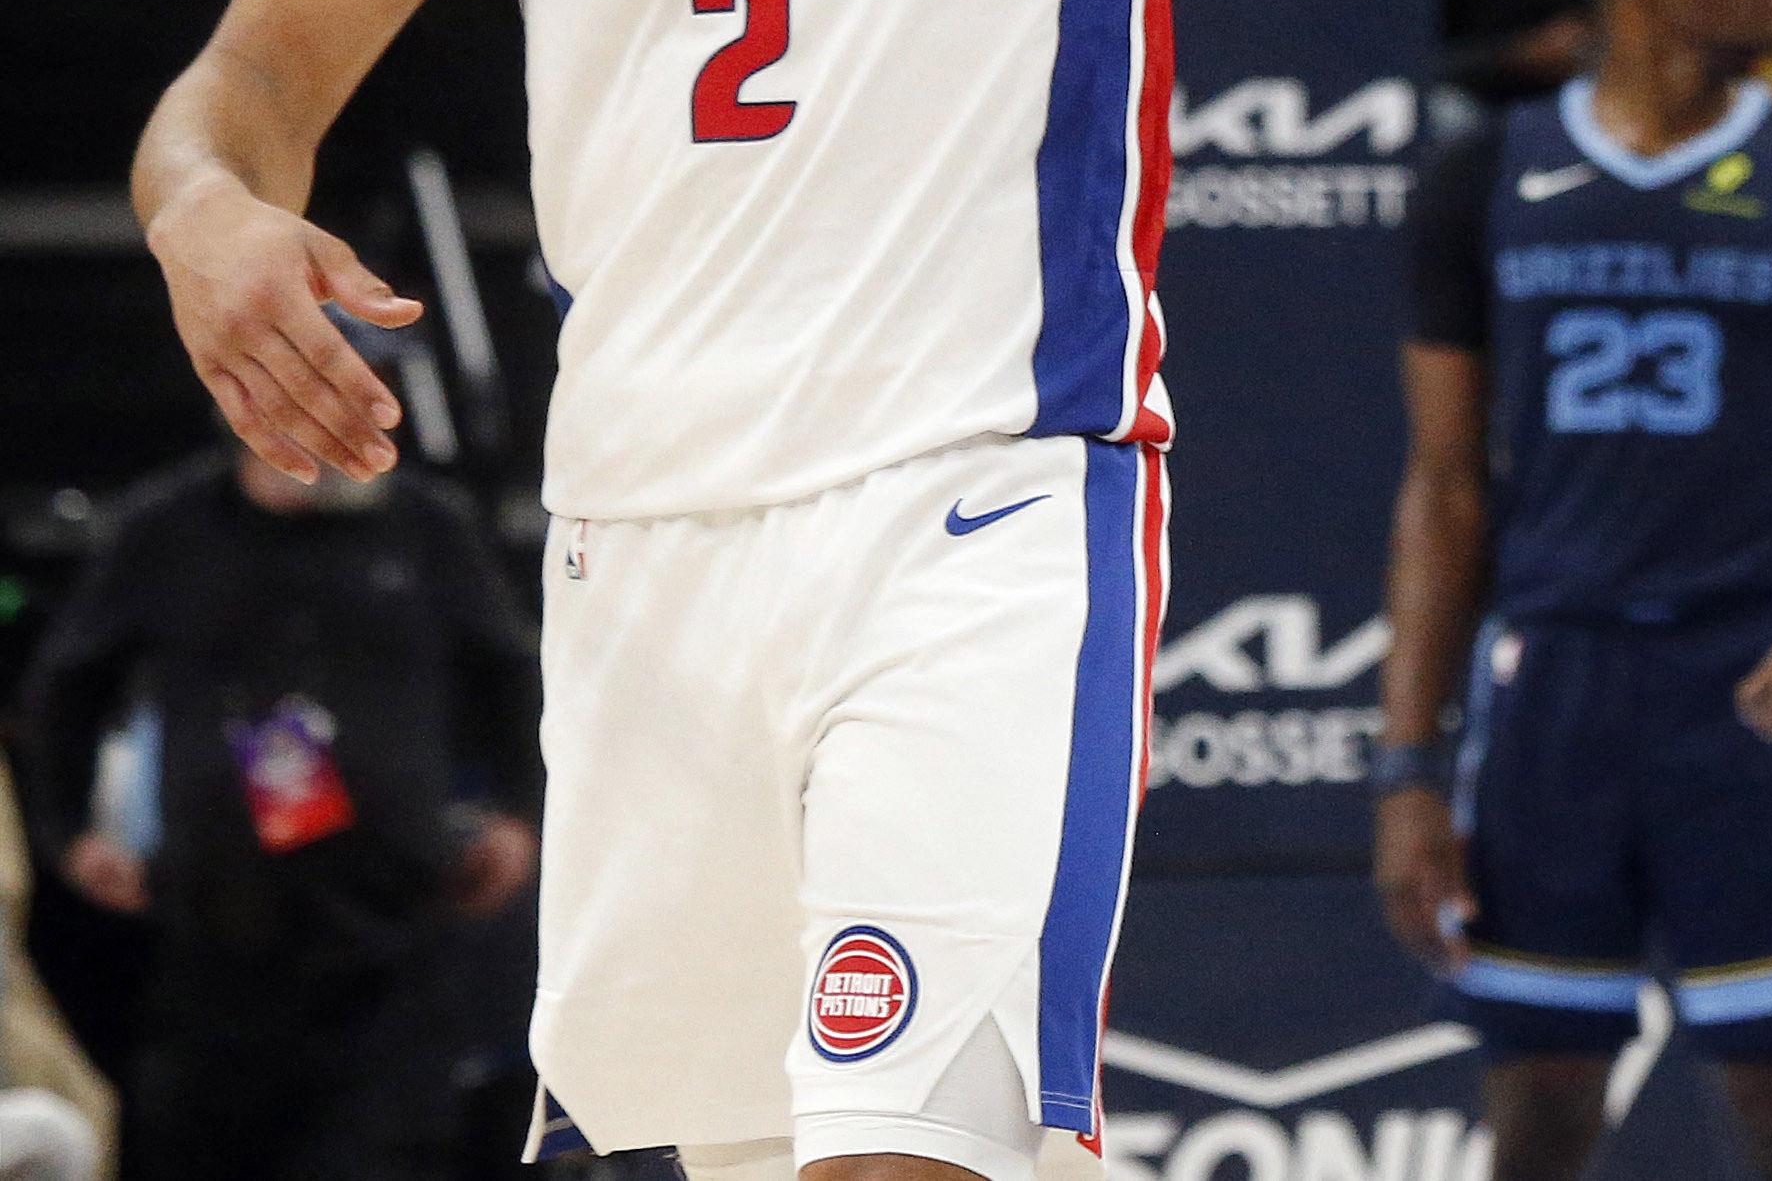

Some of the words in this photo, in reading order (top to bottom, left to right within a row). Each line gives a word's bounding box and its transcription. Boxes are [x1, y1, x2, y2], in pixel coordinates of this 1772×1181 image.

[1546, 309, 1725, 436] 23
[824, 971, 894, 995] DETROIT
[820, 994, 890, 1019] PISTONS
